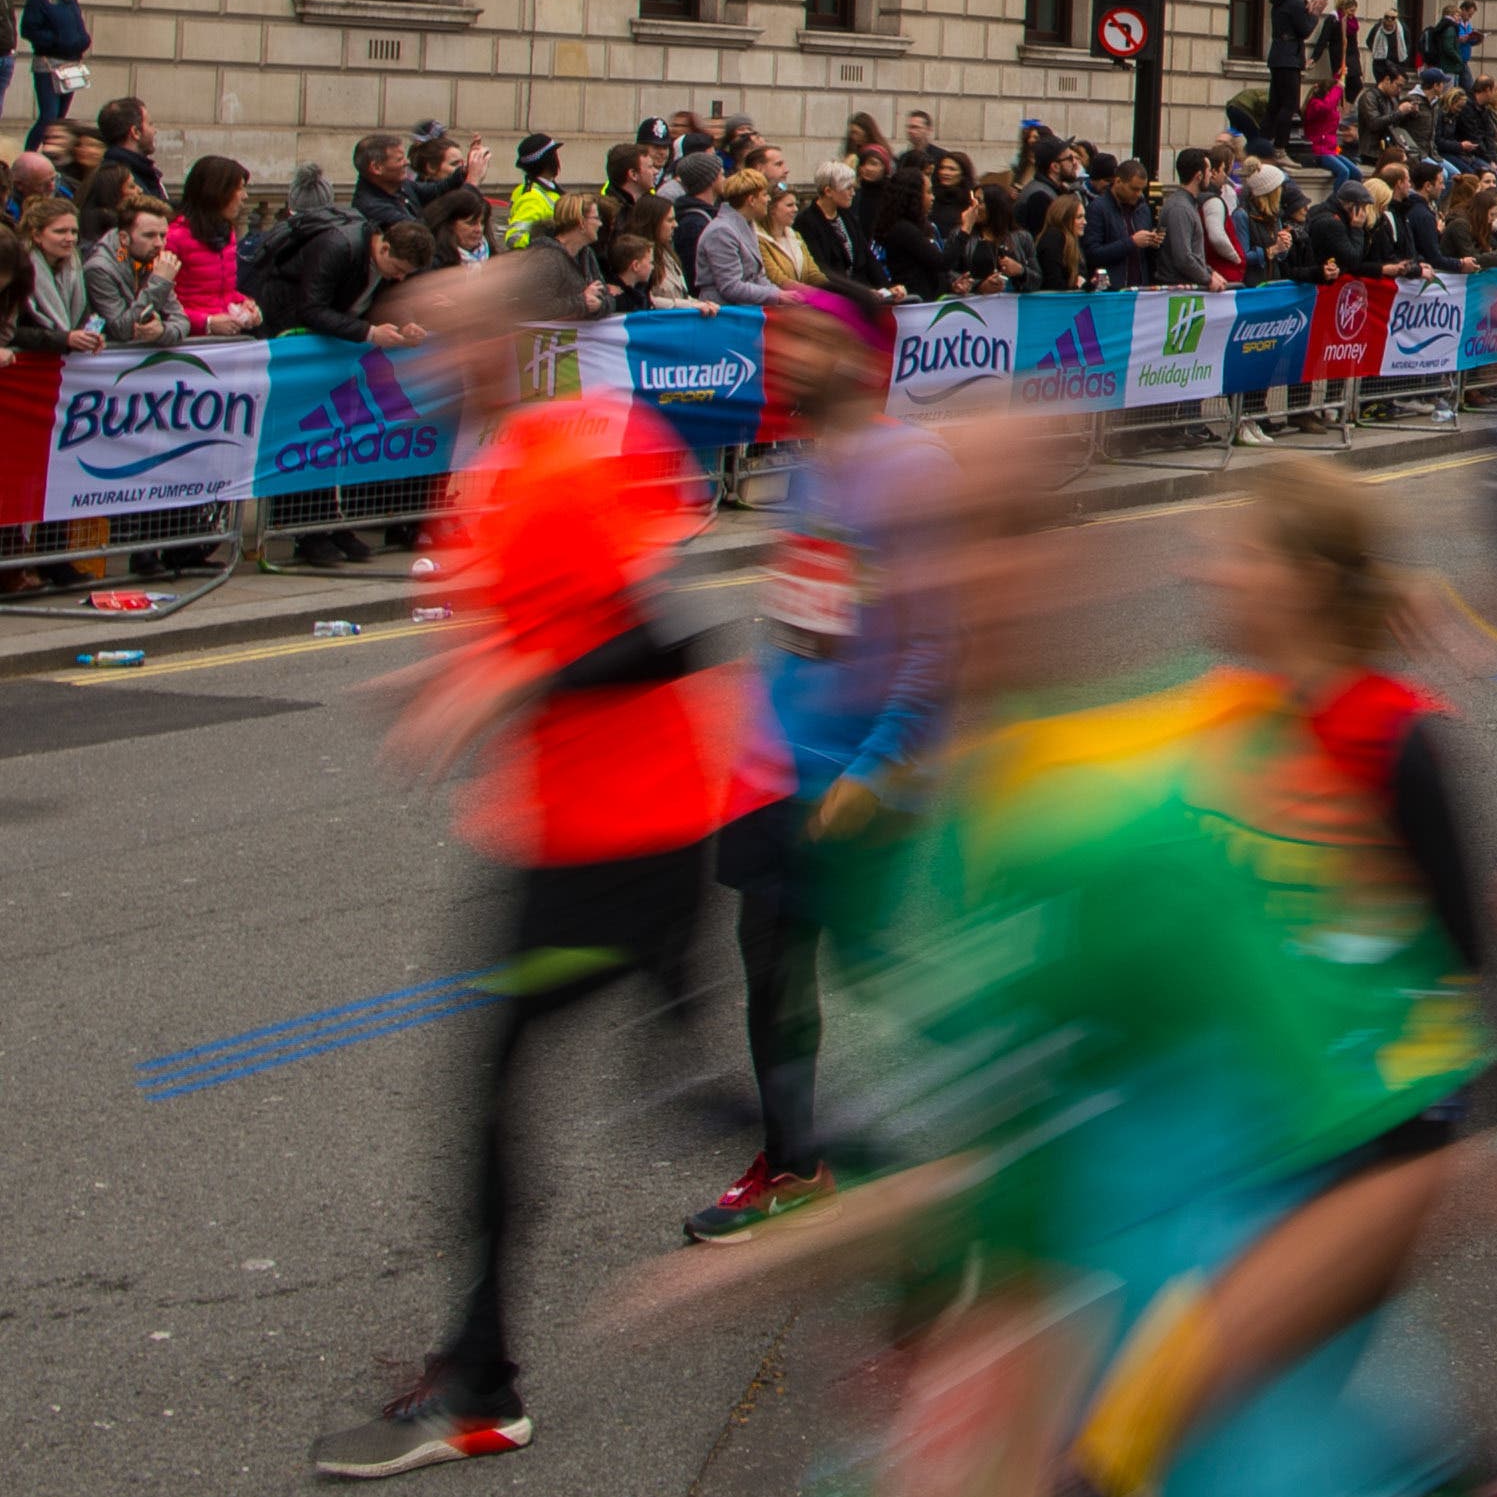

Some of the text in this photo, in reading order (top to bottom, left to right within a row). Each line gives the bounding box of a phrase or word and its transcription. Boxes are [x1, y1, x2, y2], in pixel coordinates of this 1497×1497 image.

[1233, 314, 1298, 342] Lucozade
[1390, 296, 1461, 333] Buxton
[895, 328, 1010, 383] Buxton
[1241, 340, 1277, 353] SPORT
[1323, 342, 1367, 364] money
[641, 357, 738, 390] Lucozade
[1021, 367, 1117, 403] adidas
[1138, 360, 1213, 388] Holiday Inn
[58, 380, 257, 452] Buxton
[275, 421, 438, 474] adidas
[71, 482, 228, 508] NATURALLY PUMPED UP
